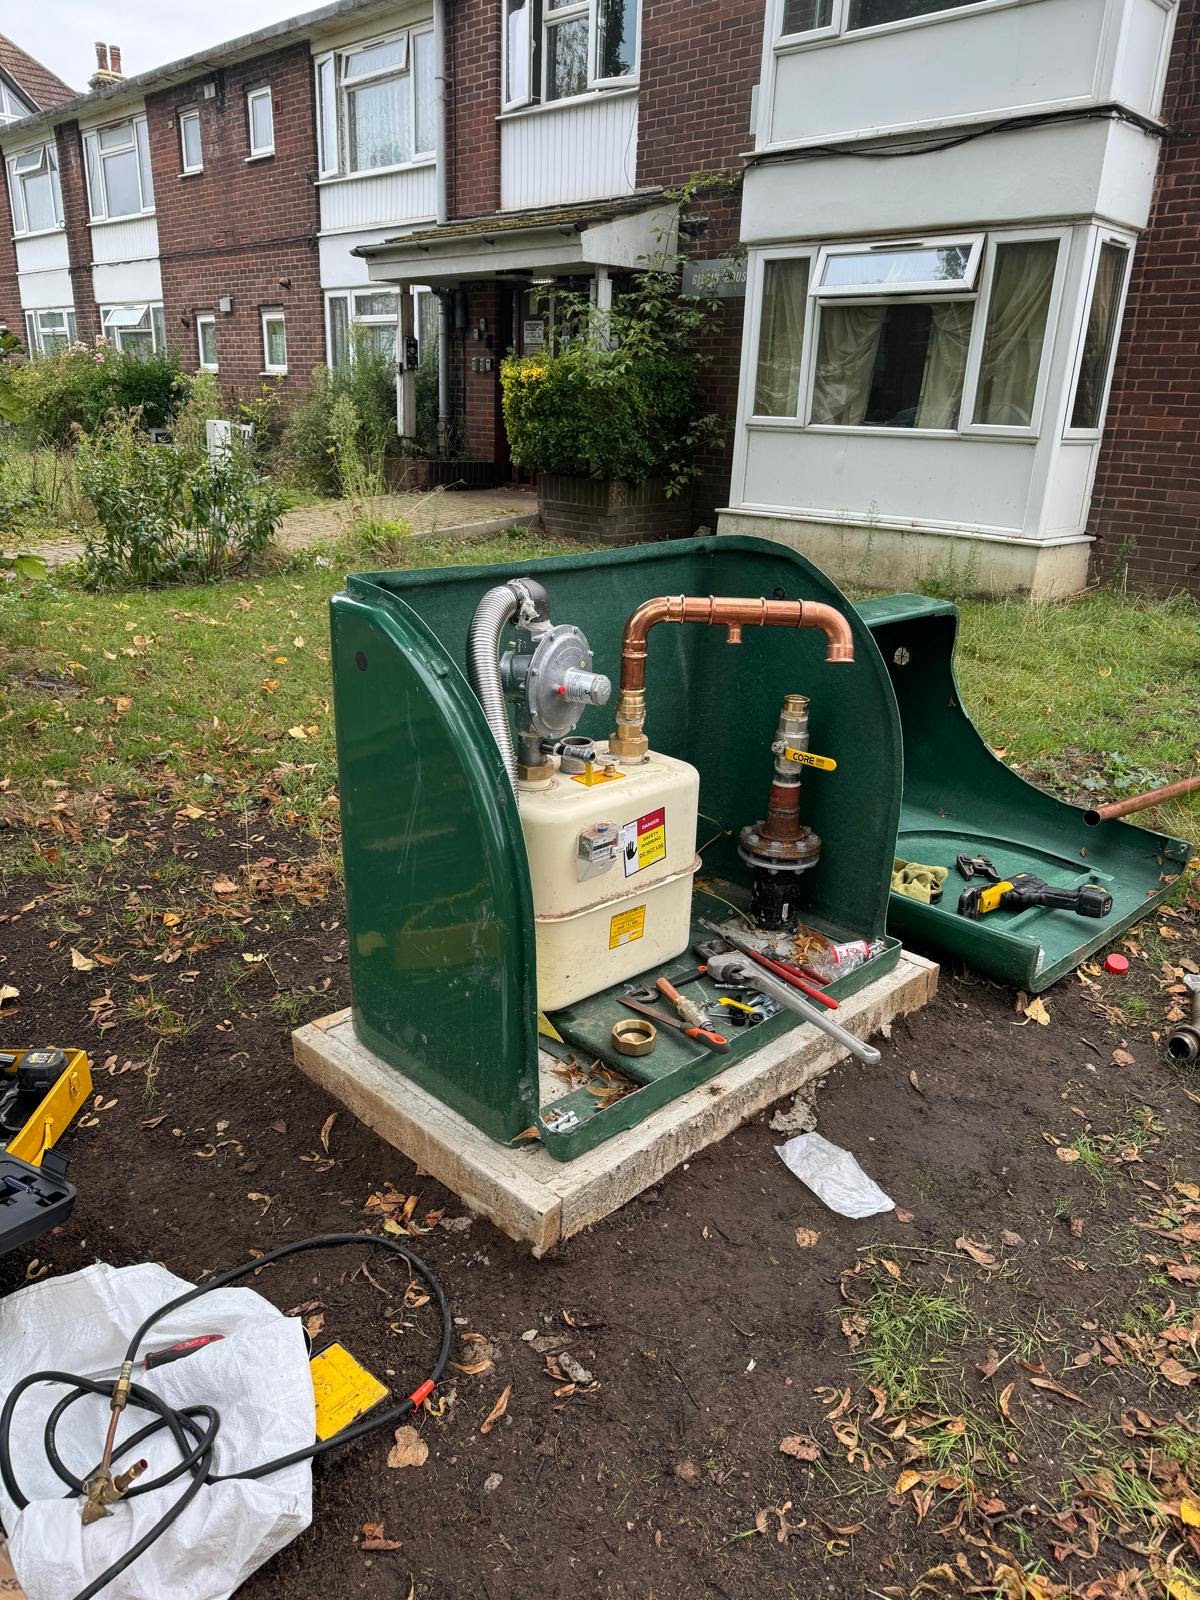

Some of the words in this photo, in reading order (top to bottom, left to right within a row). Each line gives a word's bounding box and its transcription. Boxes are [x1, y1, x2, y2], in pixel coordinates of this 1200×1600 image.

[792, 752, 814, 764] CORE
[642, 818, 660, 830] DANGER
[642, 836, 661, 848] WARNING
[643, 832, 658, 841] SAFETY
